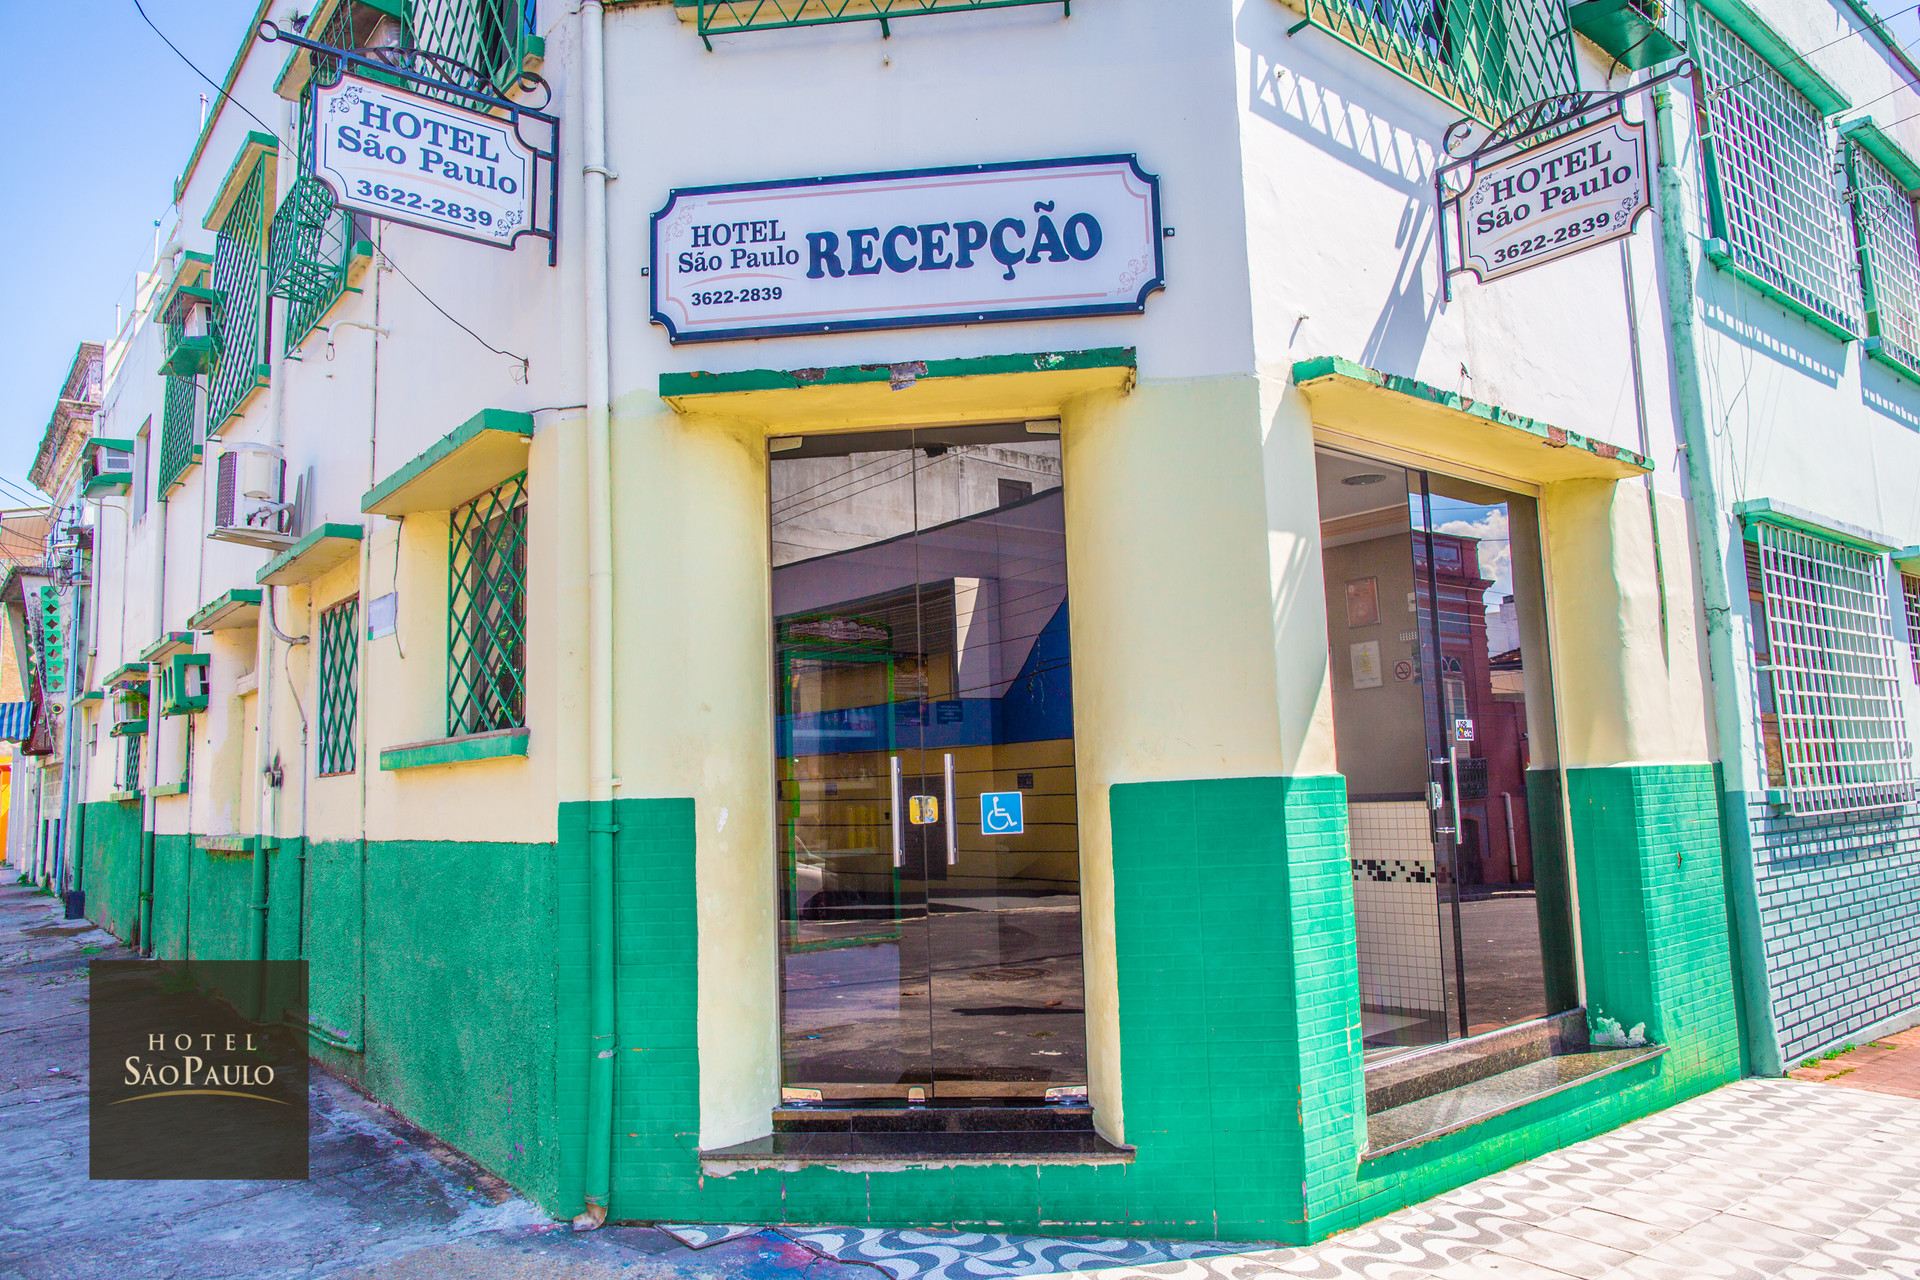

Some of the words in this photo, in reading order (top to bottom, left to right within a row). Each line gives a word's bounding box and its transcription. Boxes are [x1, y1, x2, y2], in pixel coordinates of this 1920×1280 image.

[337, 125, 407, 165] São
[418, 147, 518, 195] Paulo
[358, 99, 500, 164] HOTEL
[1476, 204, 1531, 236] São
[1540, 165, 1632, 213] Paulo
[1490, 140, 1612, 206] HOTEL
[356, 179, 493, 227] 3622-2839
[678, 251, 723, 274] São
[730, 245, 800, 269] Paulo
[690, 219, 787, 248] HOTEL
[804, 199, 1103, 281] RECEPÇÃO
[1493, 212, 1611, 264] 3622-2839
[691, 286, 783, 306] 3622-2839
